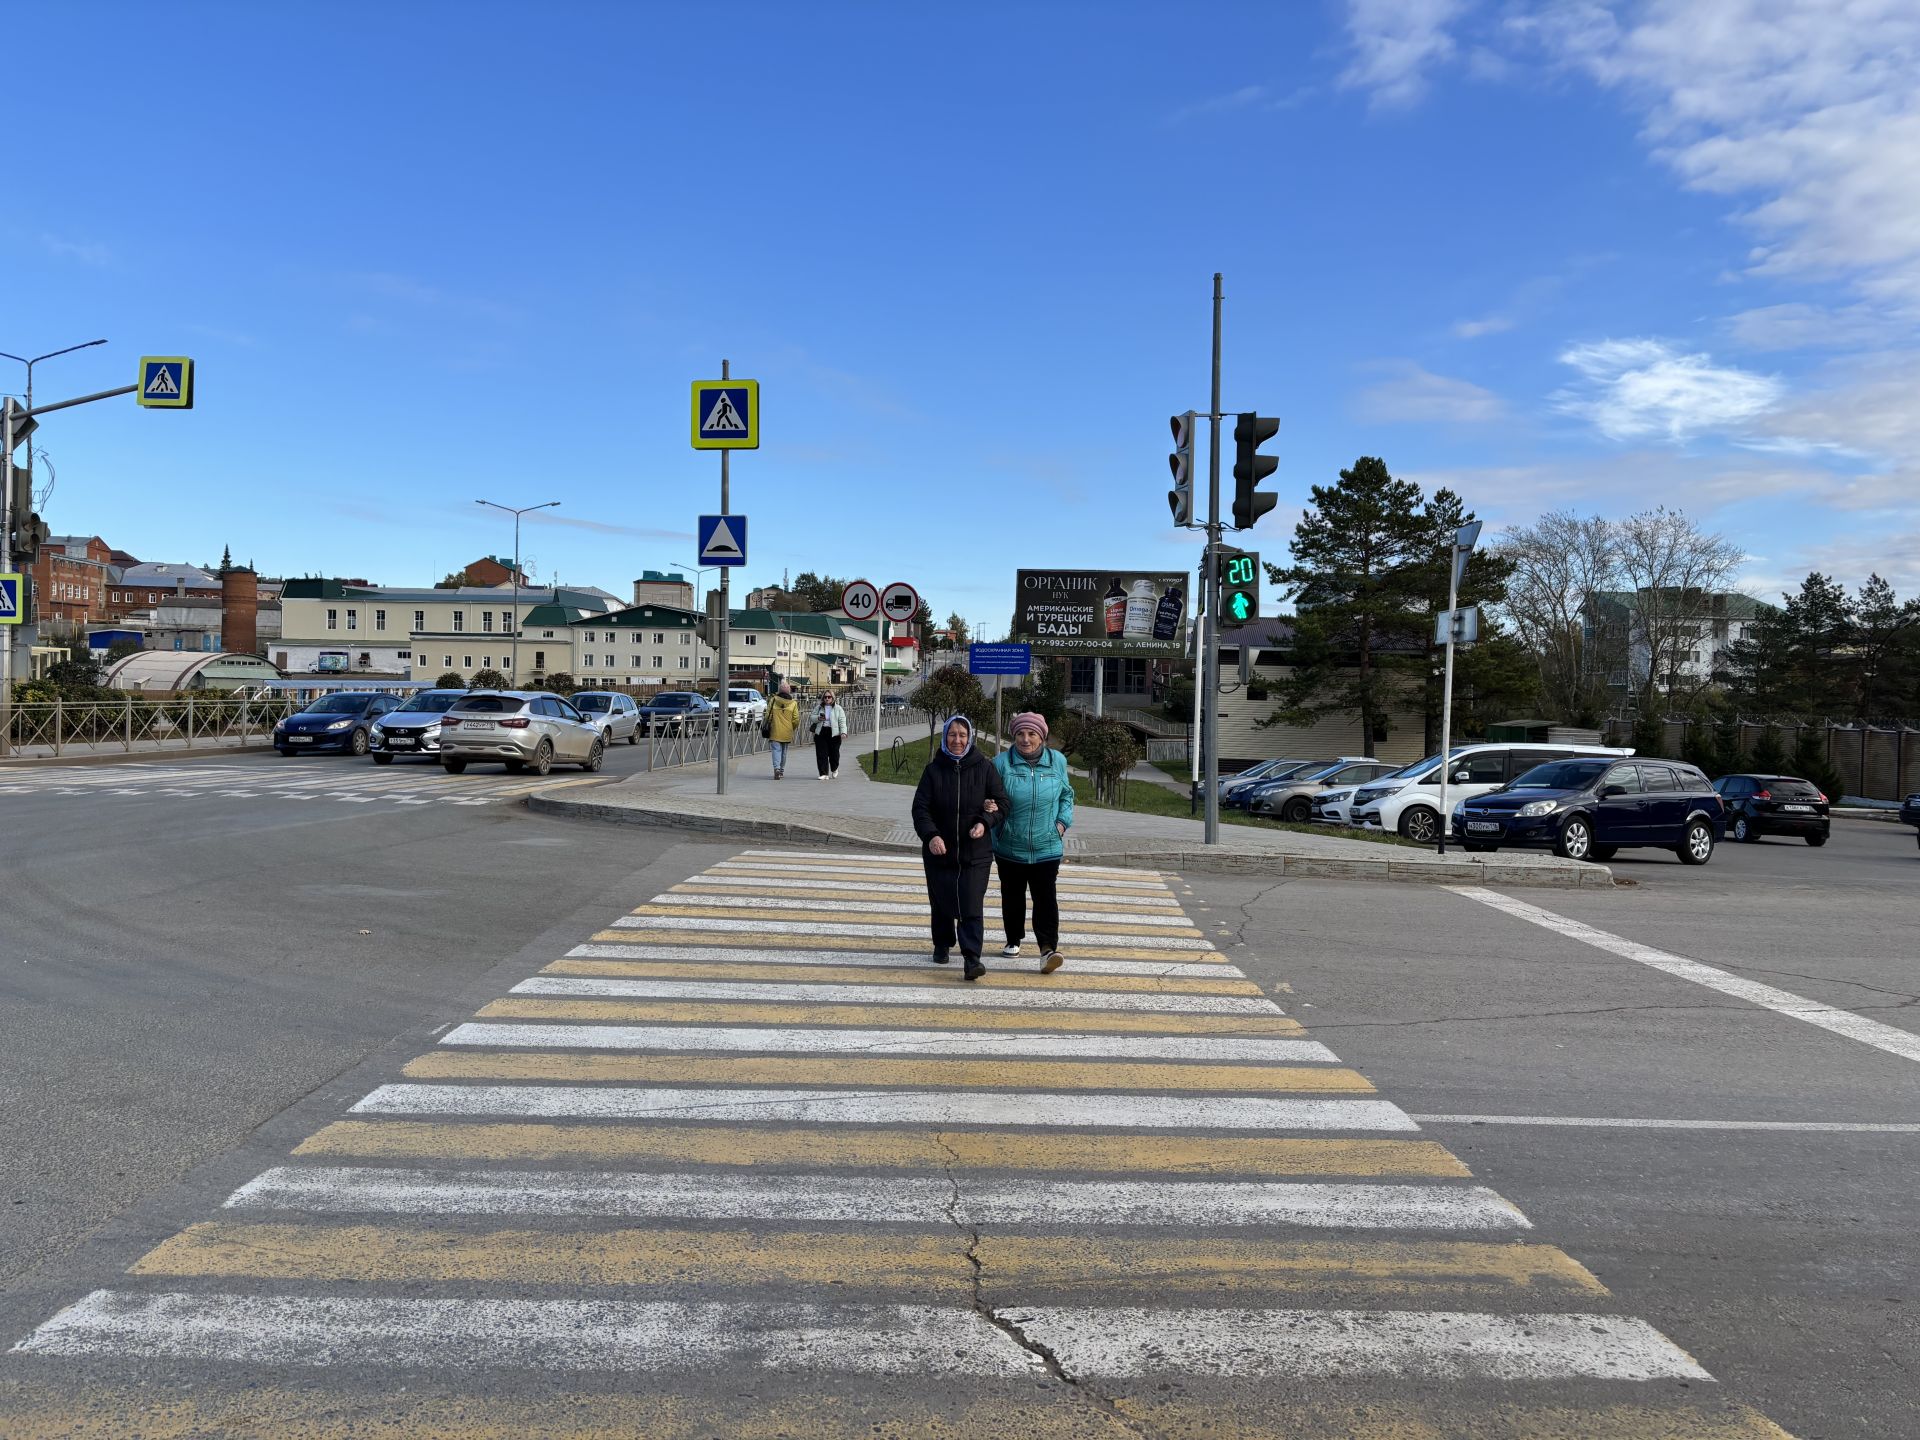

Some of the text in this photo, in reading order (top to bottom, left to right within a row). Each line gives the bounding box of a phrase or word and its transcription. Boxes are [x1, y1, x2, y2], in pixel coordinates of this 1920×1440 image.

[1229, 558, 1253, 584] 20
[1024, 576, 1098, 590] ОРГАНИК
[849, 593, 872, 608] 40
[1027, 605, 1094, 613] АМЕРИКАНСКИЕ
[1026, 613, 1094, 623] И ТУРЕЦКИЕ
[1037, 623, 1082, 636] БАДЫ
[1036, 640, 1113, 648] +7-992-077-00-04
